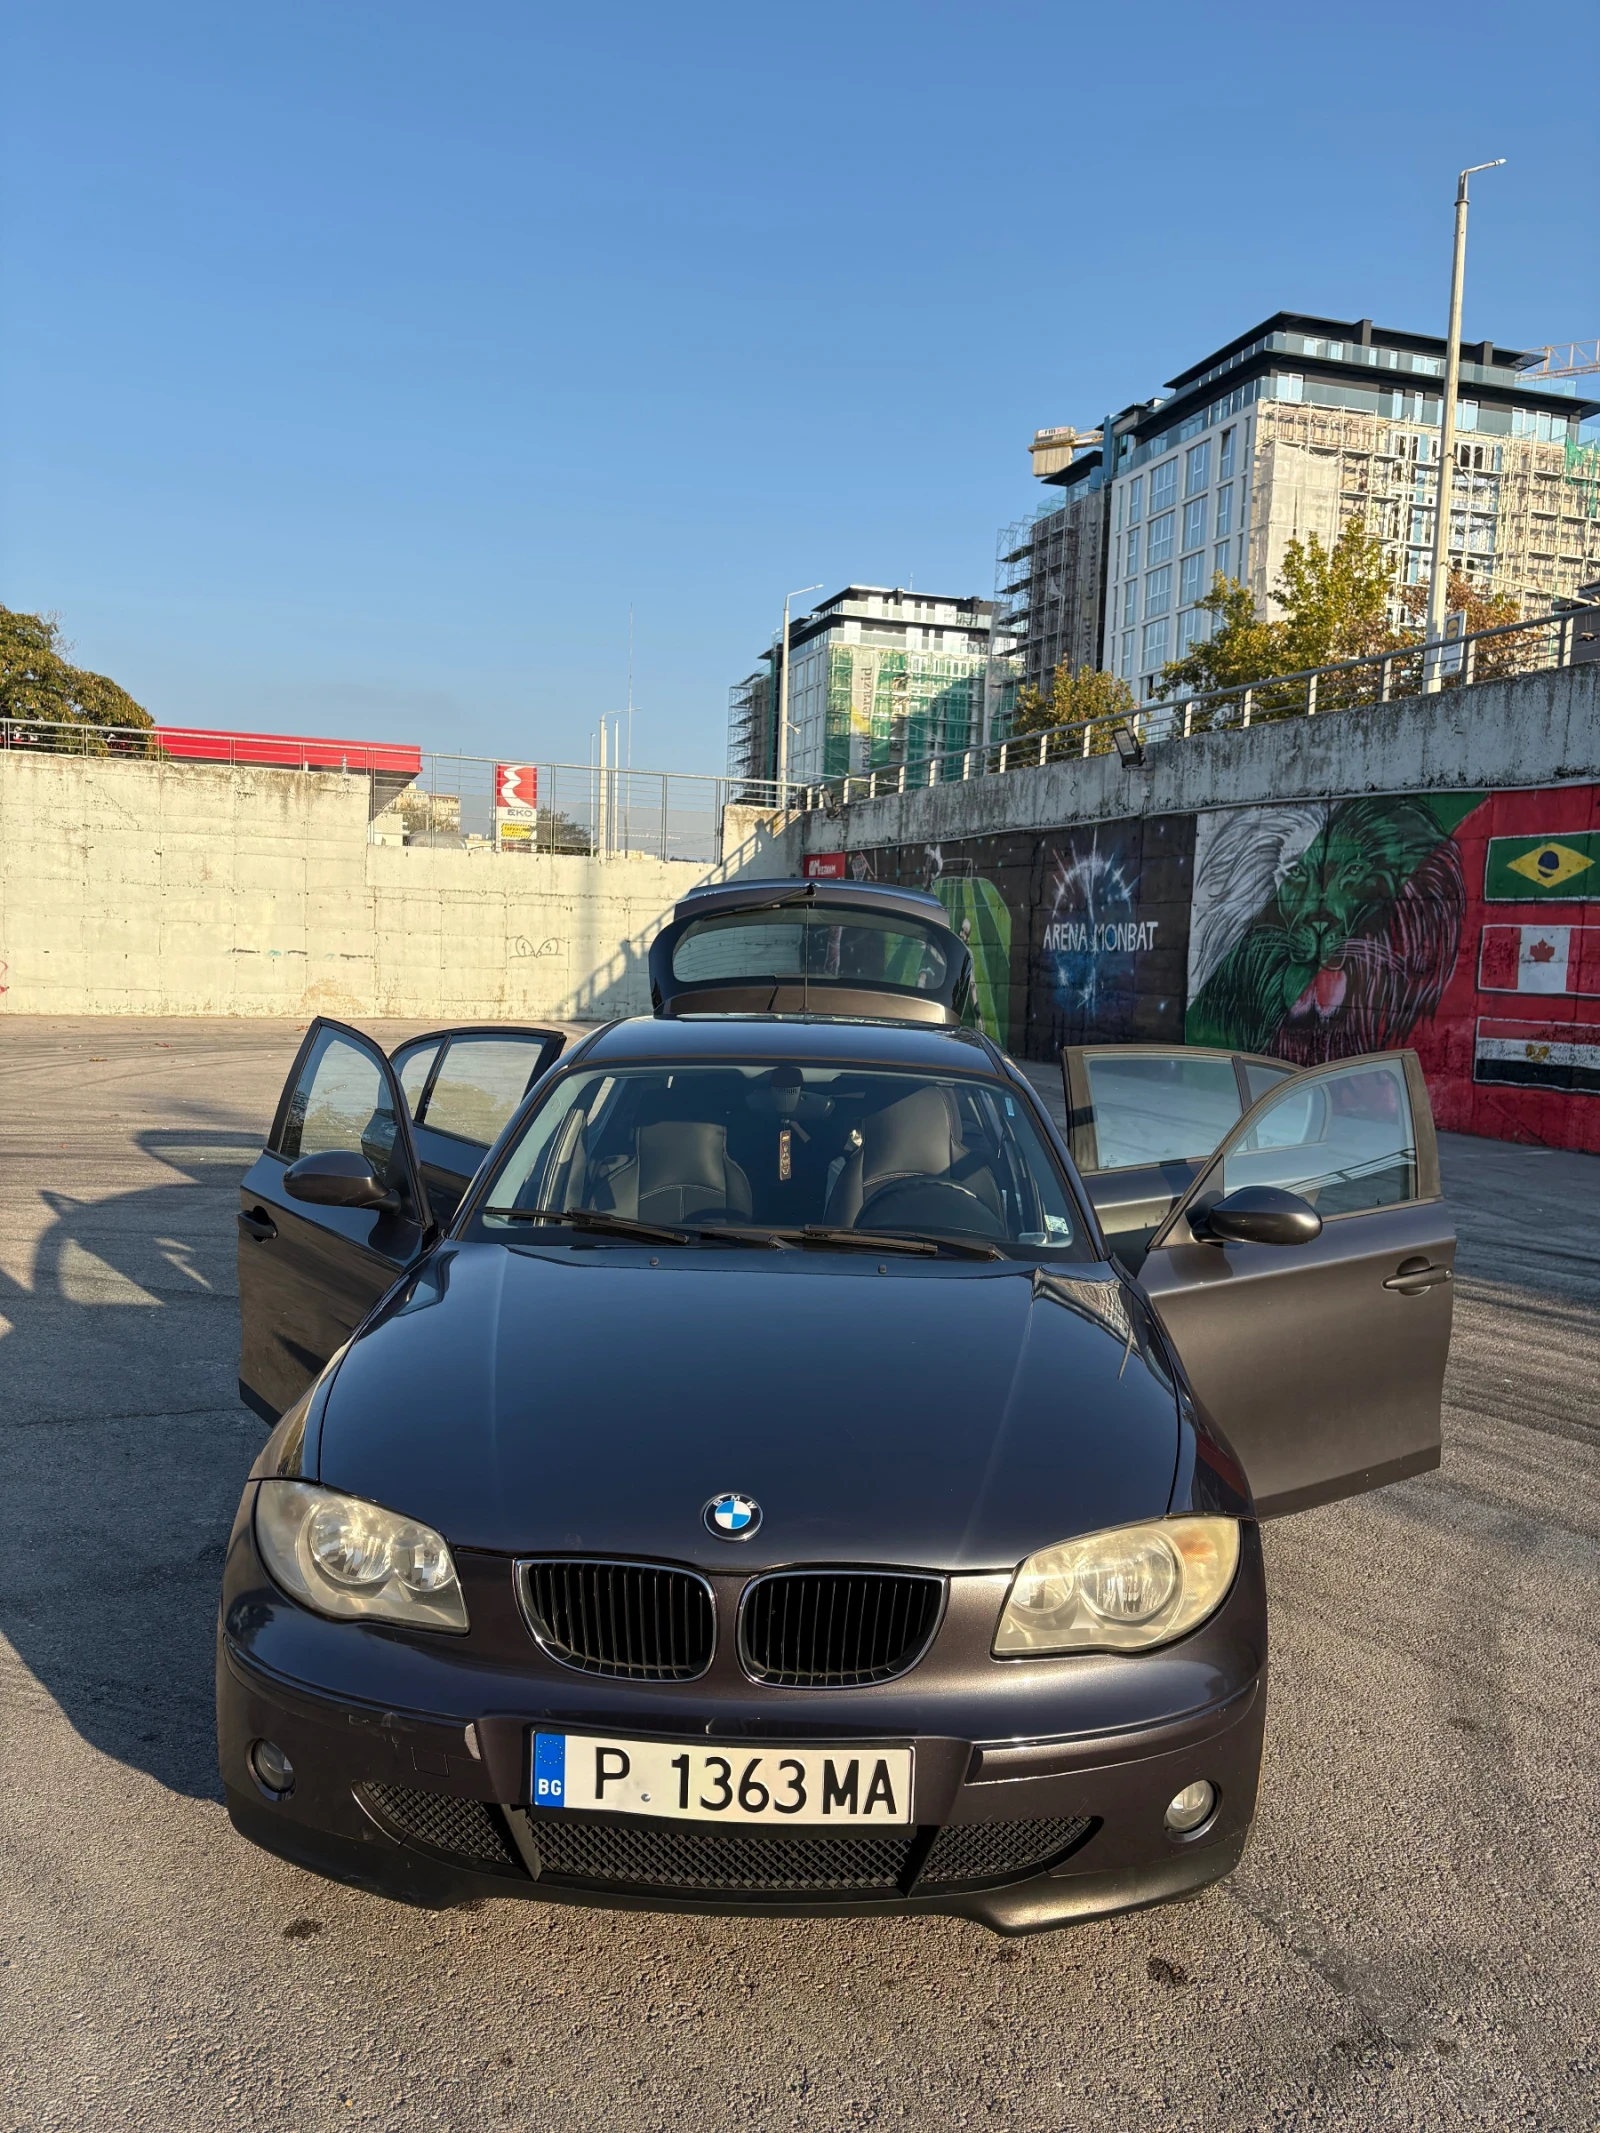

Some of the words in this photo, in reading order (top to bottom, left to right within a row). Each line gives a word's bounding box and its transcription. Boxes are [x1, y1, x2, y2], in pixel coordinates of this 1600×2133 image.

[507, 809, 533, 818] EKO
[1043, 922, 1089, 952] ARENA
[713, 1495, 757, 1509] BMW
[538, 1778, 562, 1796] BG
[595, 1746, 630, 1799] P
[671, 1753, 807, 1814] 1363
[822, 1759, 898, 1815] MA
